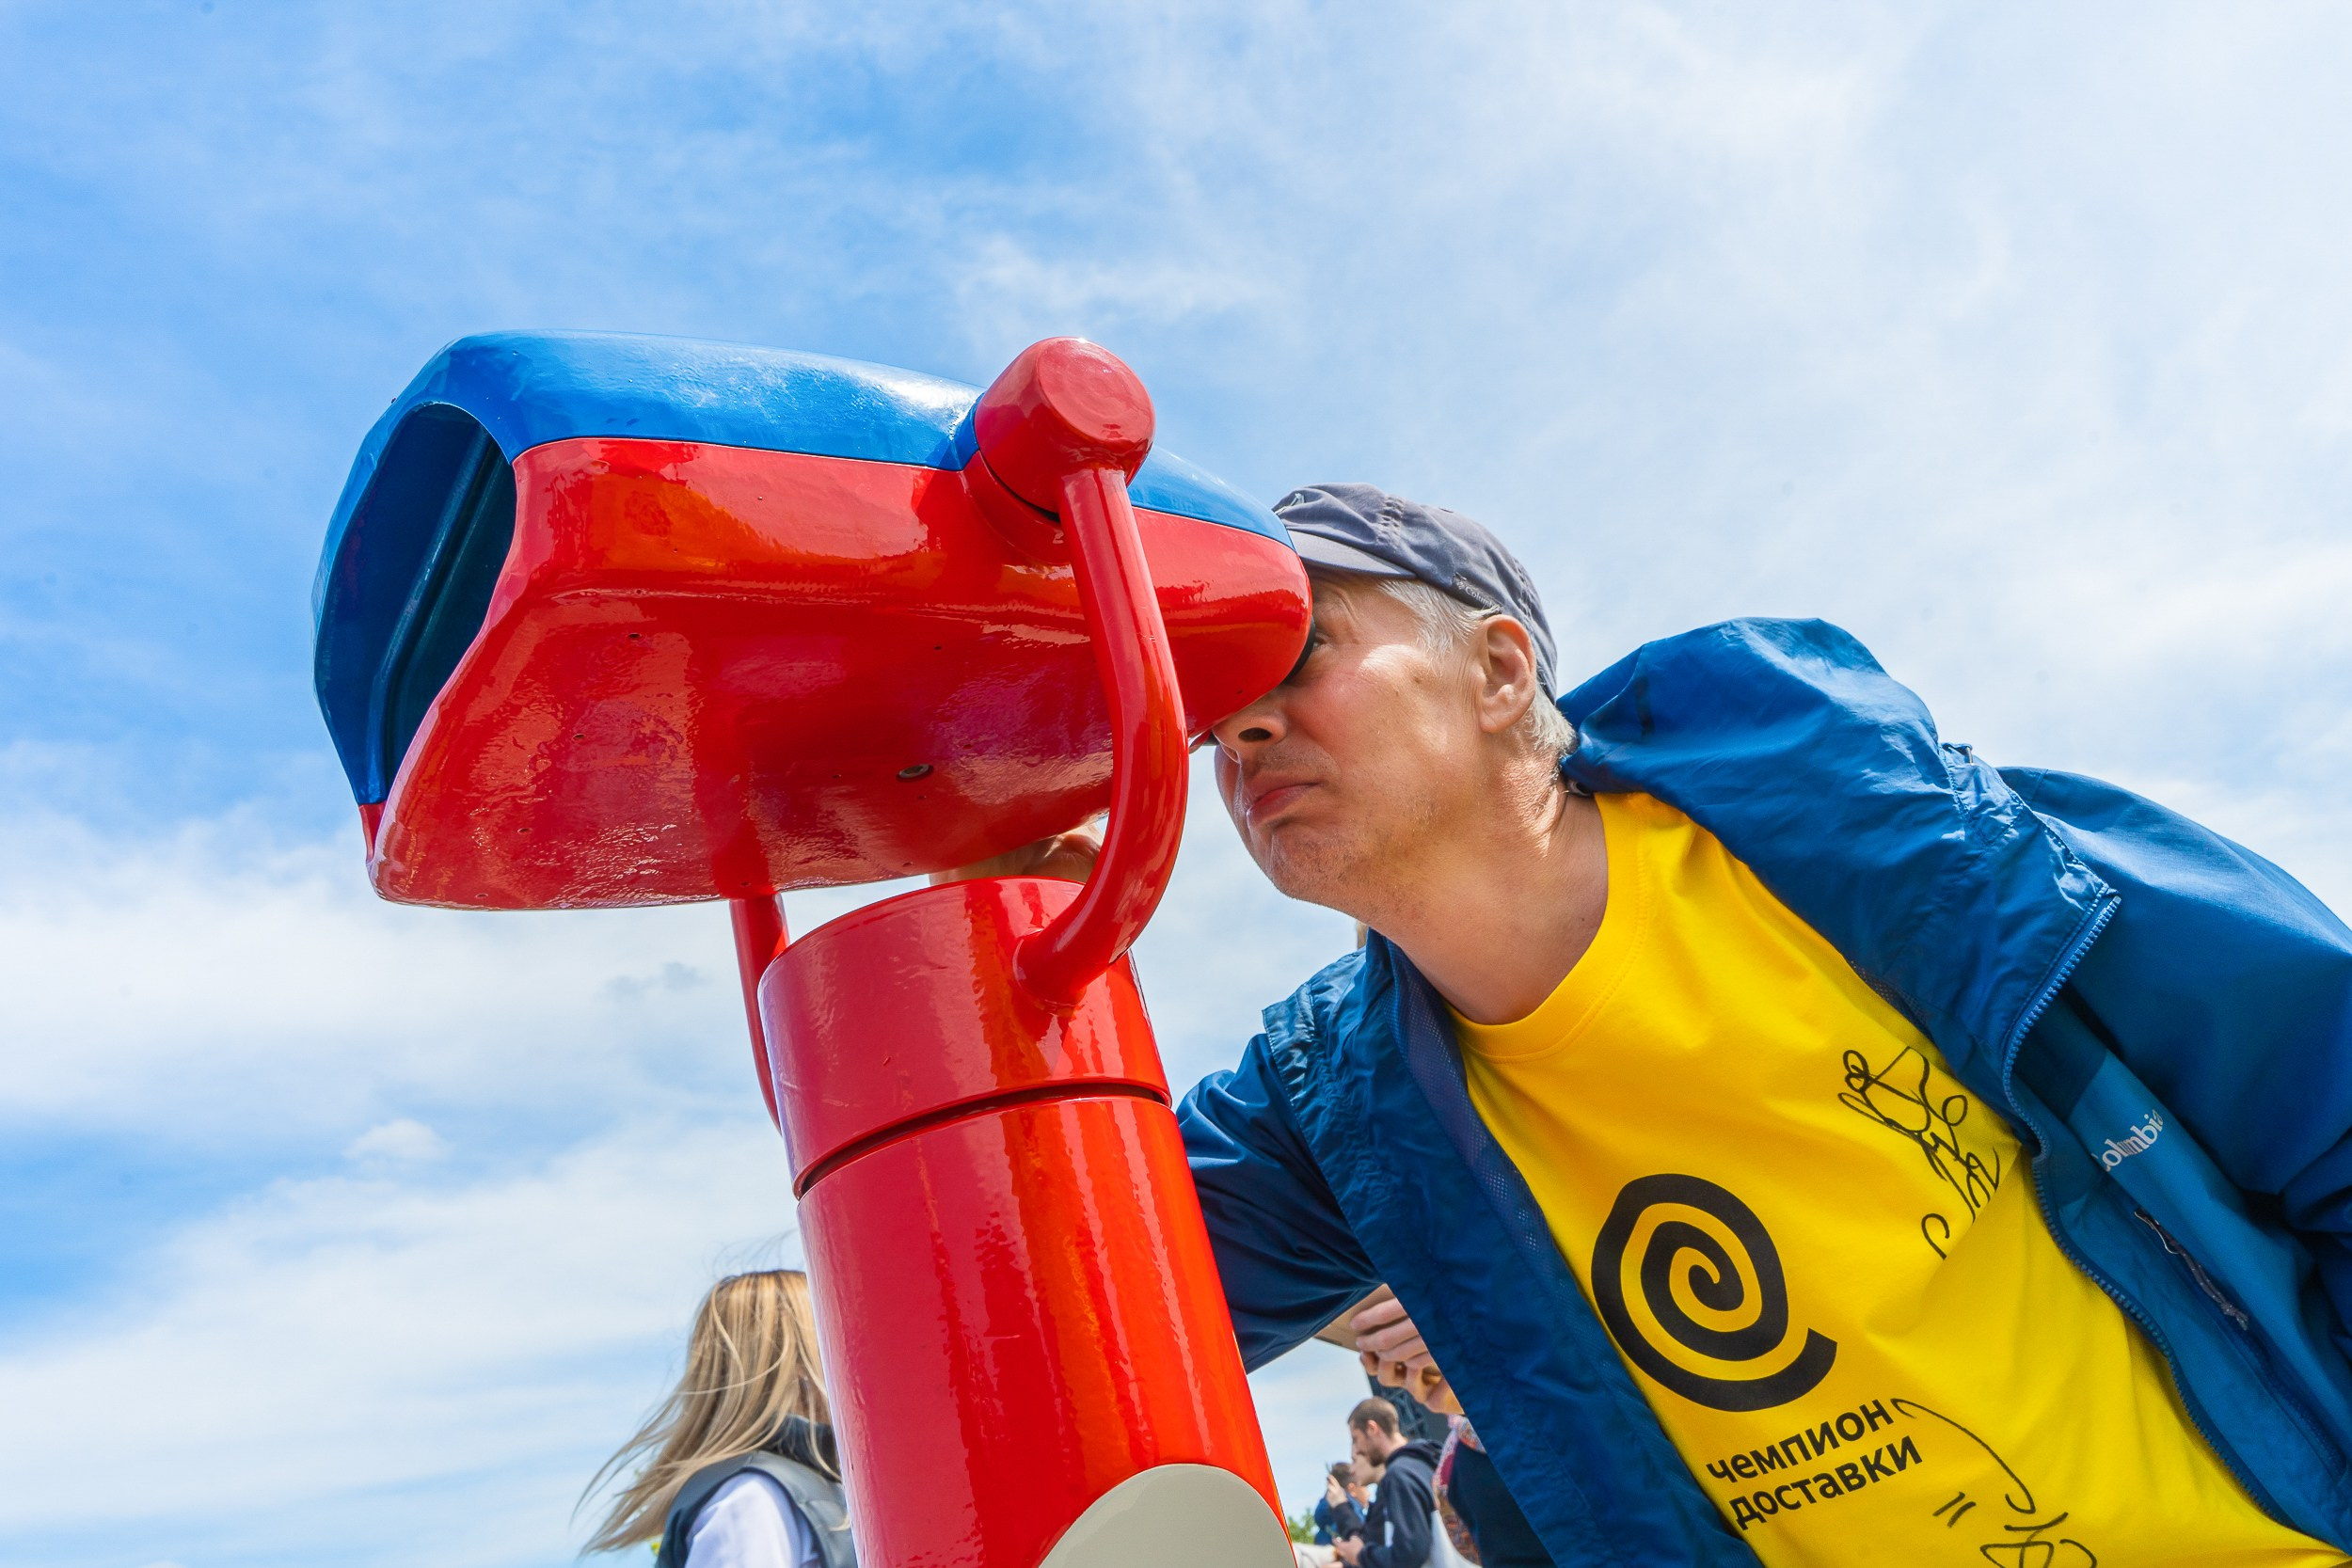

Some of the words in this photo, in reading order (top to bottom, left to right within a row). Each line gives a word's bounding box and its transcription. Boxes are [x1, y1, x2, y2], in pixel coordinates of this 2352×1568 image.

[1465, 586, 1494, 609] Colum
[2090, 1109, 2164, 1172] olumbia
[1706, 1399, 1895, 1483] чемпион
[1728, 1435, 1923, 1531] доставки
